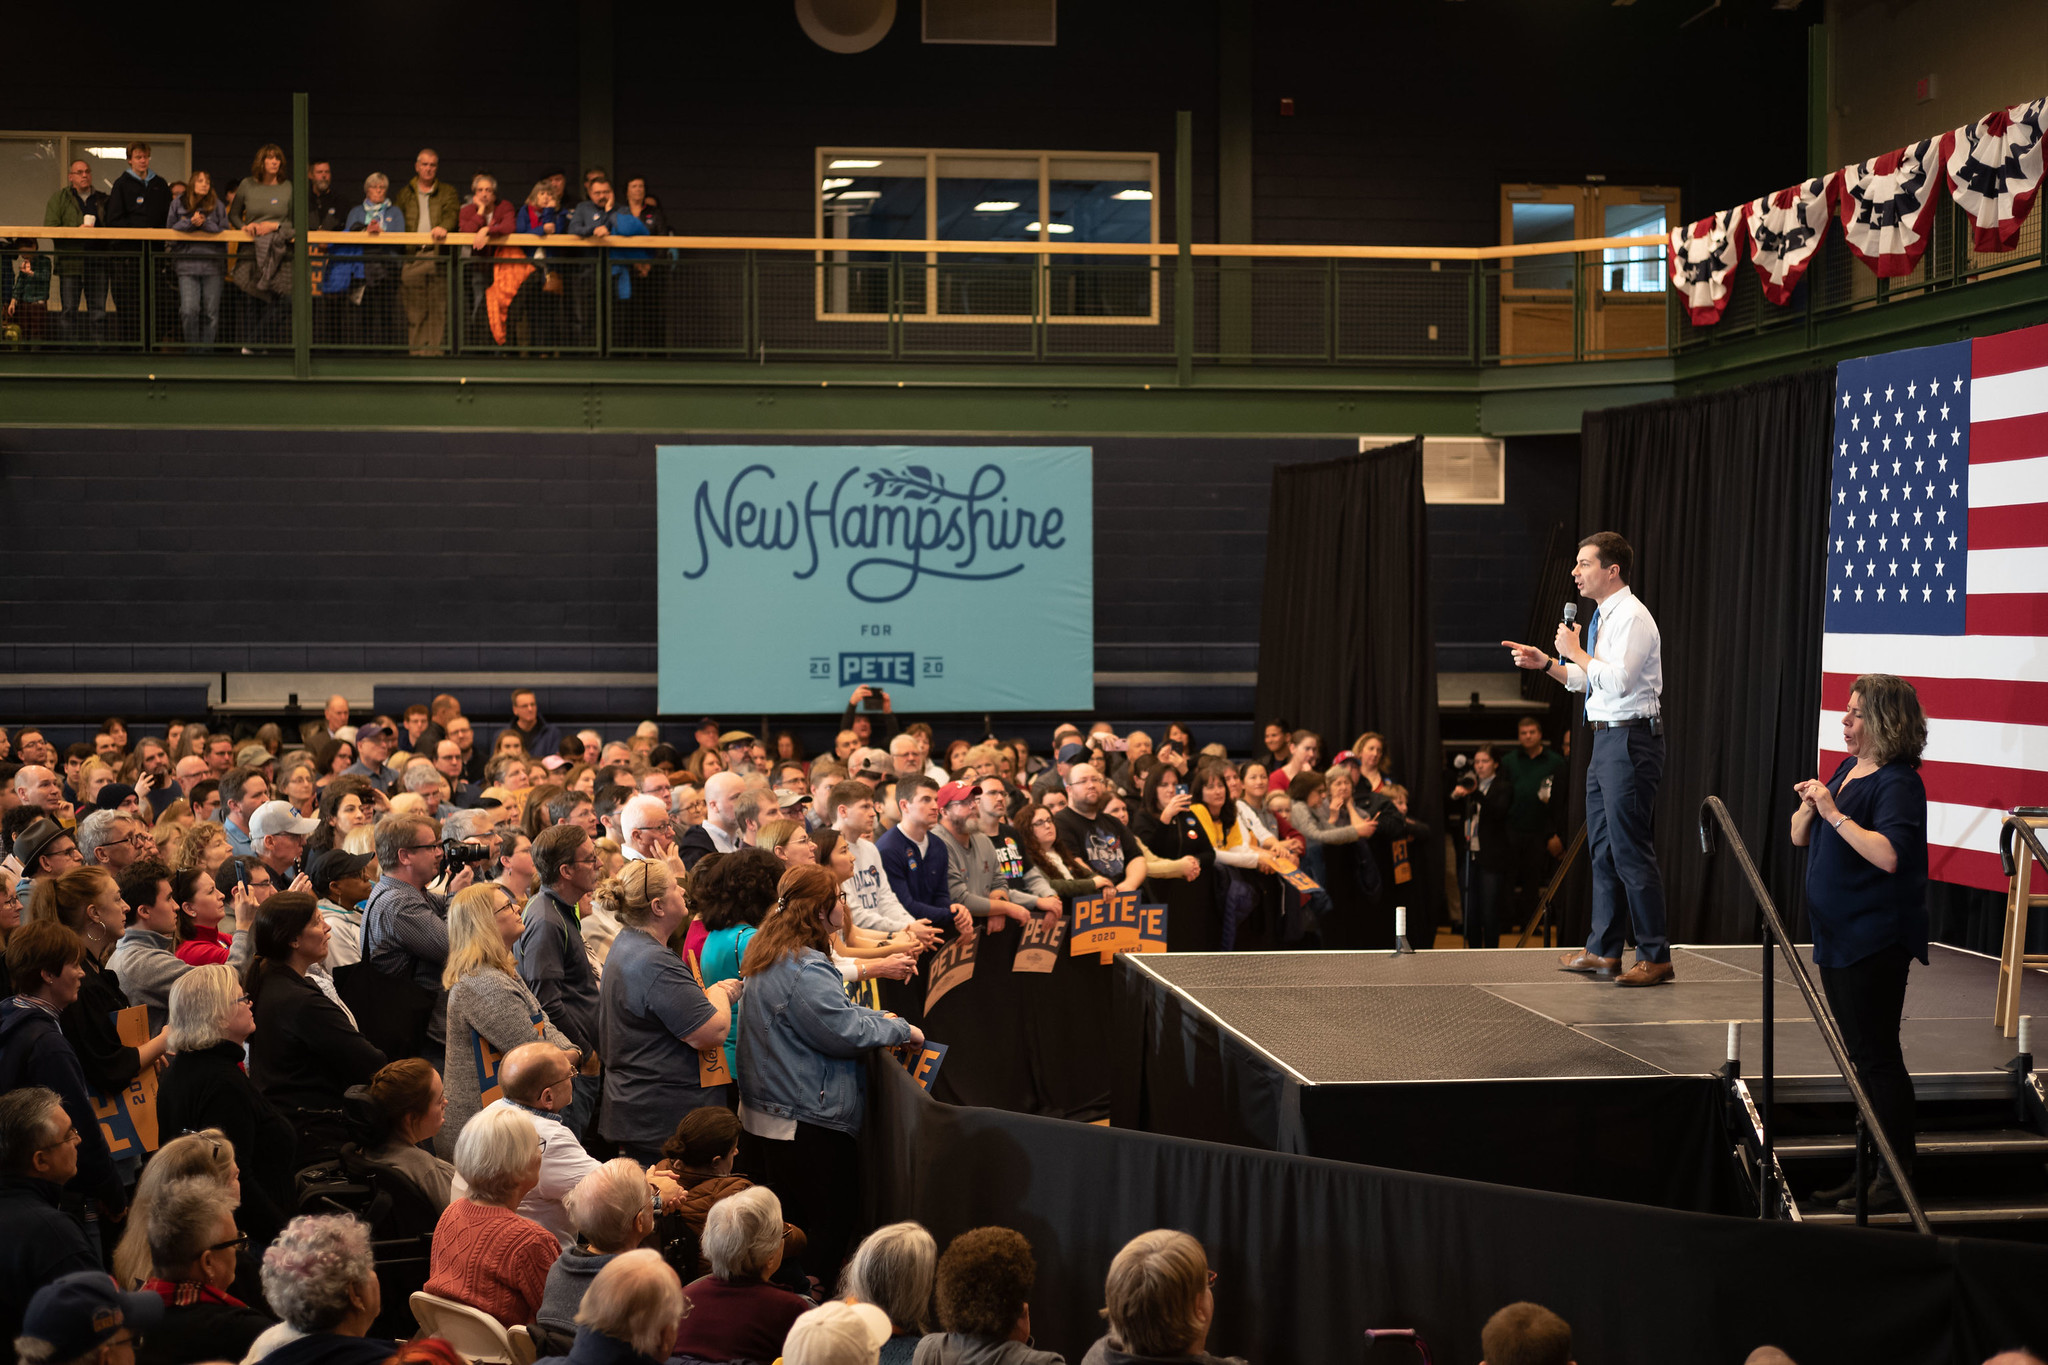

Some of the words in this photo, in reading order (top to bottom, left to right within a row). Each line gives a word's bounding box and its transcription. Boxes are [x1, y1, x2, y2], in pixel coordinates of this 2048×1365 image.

[682, 464, 798, 580] New
[793, 464, 1065, 604] Hampshire
[861, 624, 891, 636] FOR
[810, 662, 830, 674] 20
[842, 656, 911, 682] PETE
[923, 661, 943, 673] 20
[1074, 895, 1138, 930] PETE
[1020, 918, 1067, 948] PETE
[1091, 931, 1116, 943] 2020
[927, 932, 978, 992] PETE
